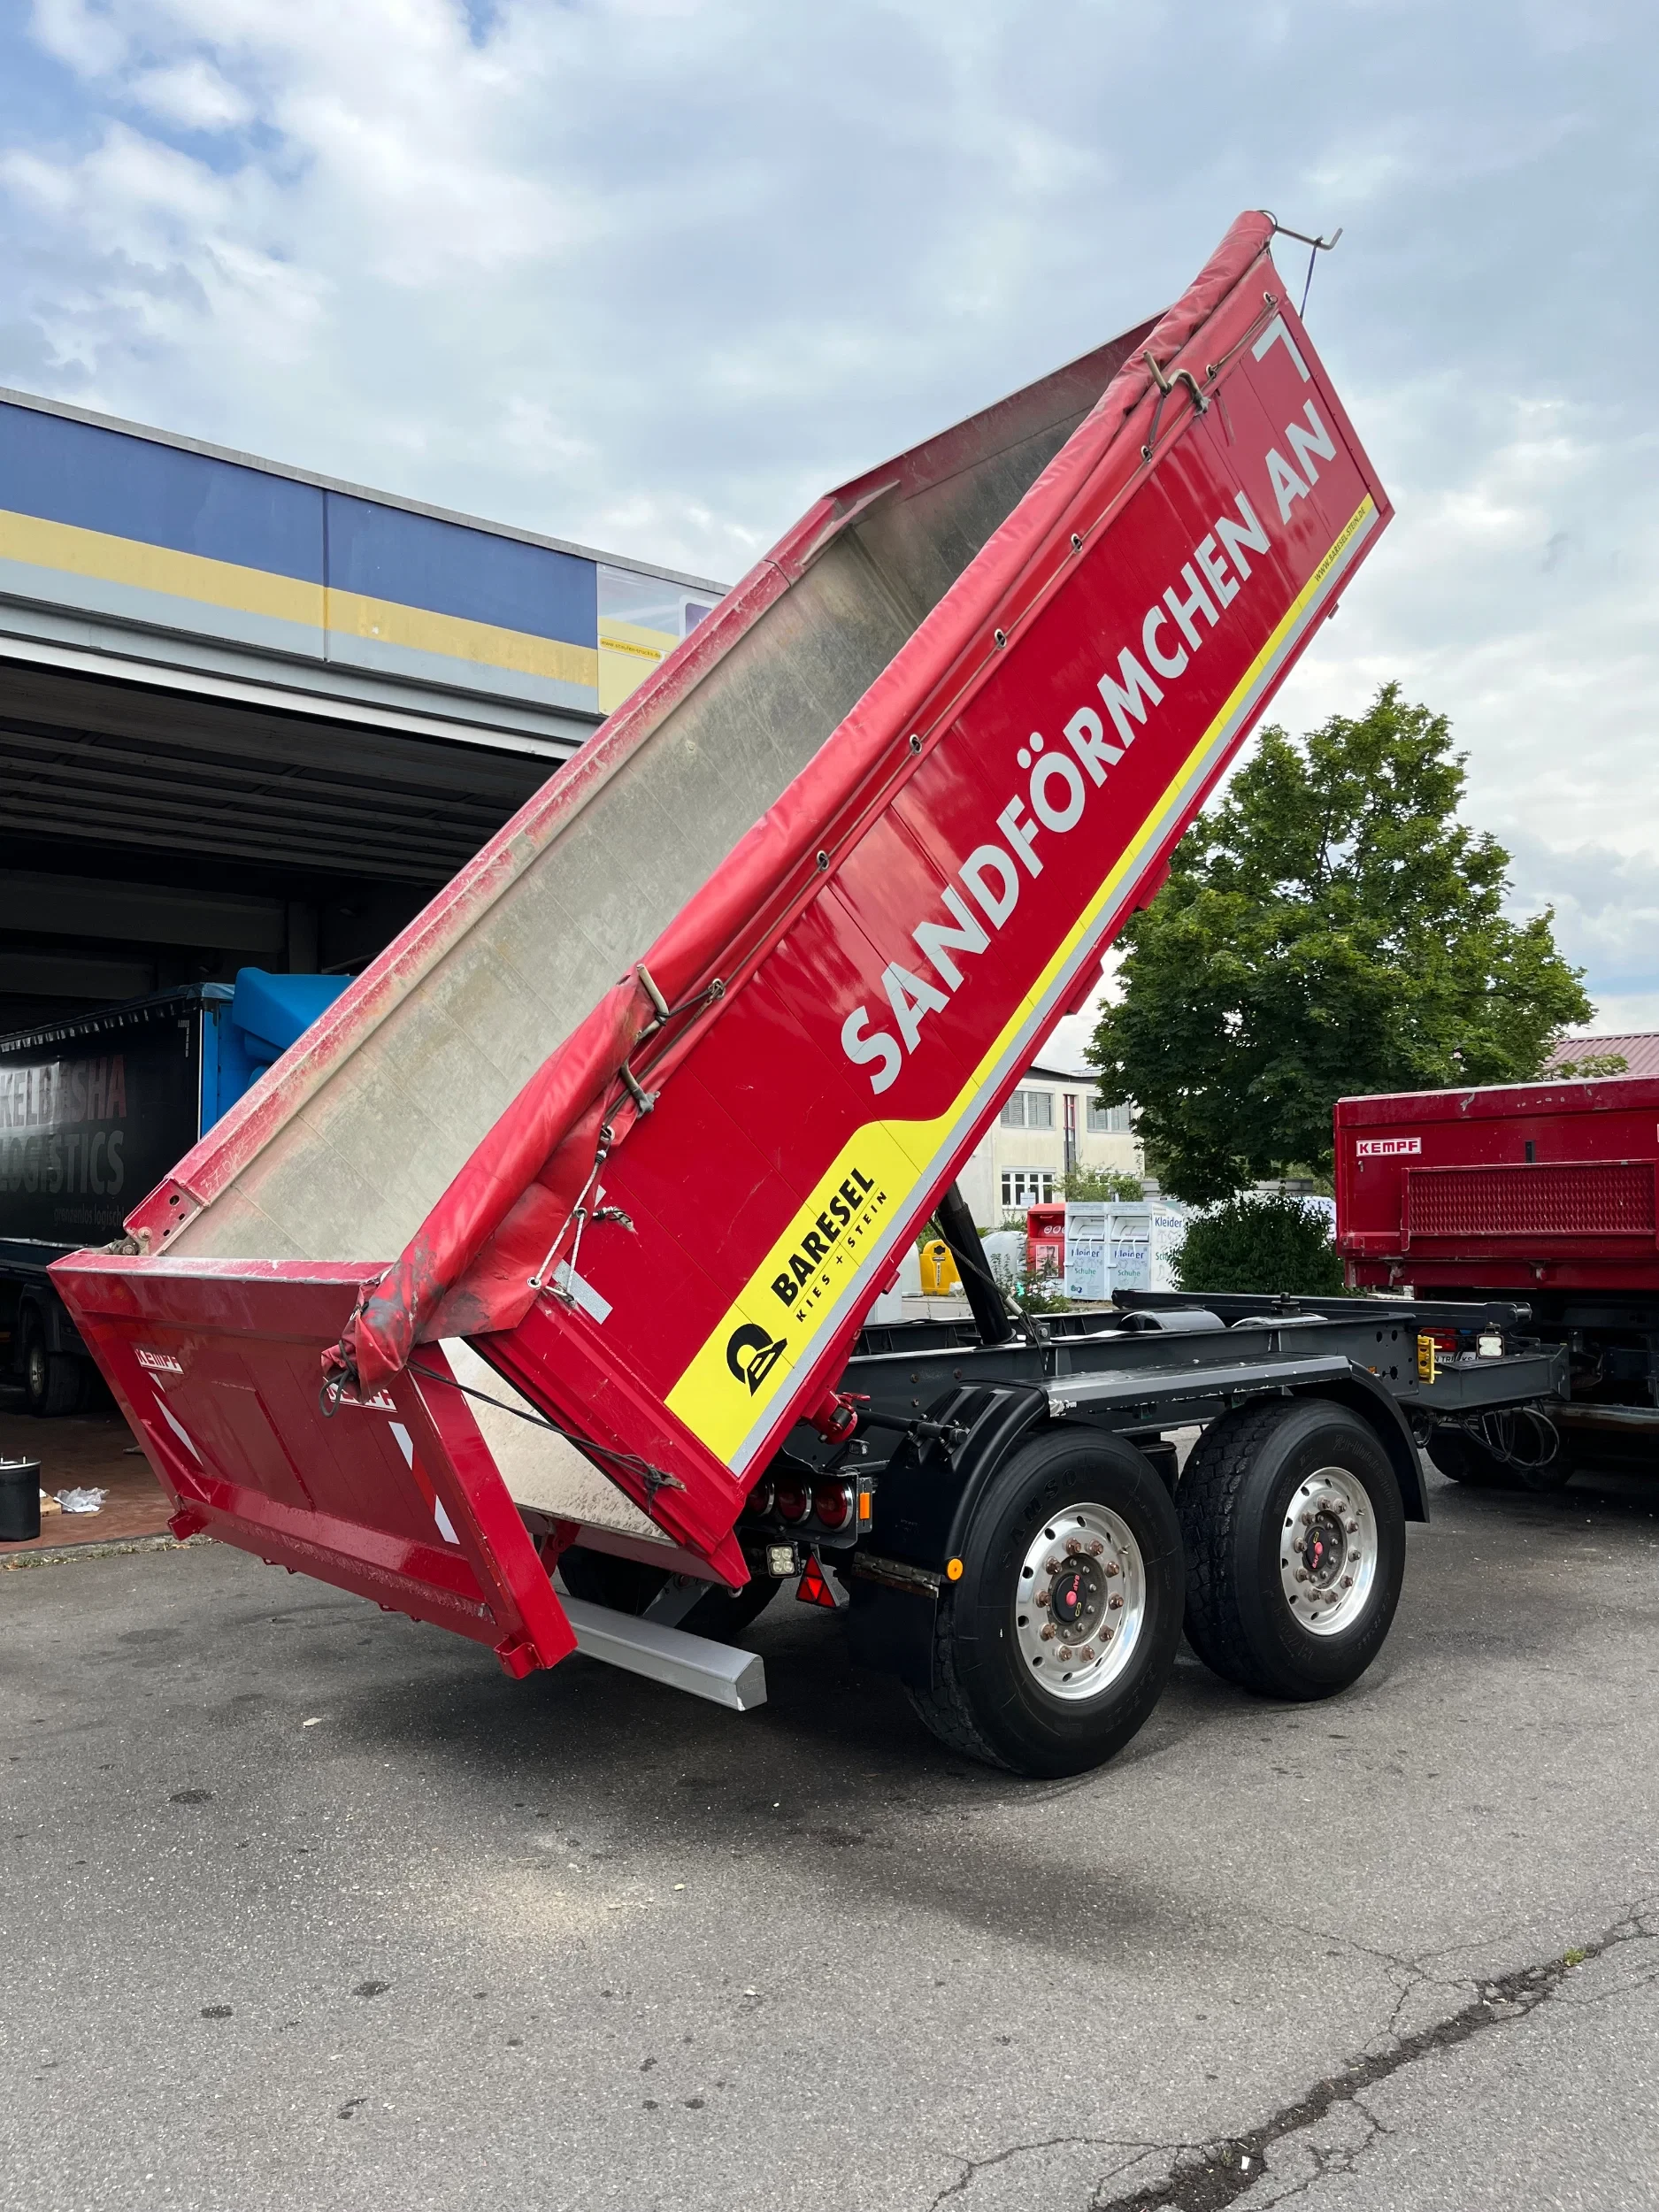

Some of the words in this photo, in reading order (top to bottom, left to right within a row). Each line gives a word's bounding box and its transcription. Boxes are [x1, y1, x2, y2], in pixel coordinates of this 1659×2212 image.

[1314, 507, 1366, 581] WWW.BARESEL-STEIN.DE
[840, 490, 1271, 1094] SANDFÖRMCHEN
[1265, 399, 1336, 525] AN
[1360, 1141, 1417, 1154] KEMPF
[54, 1203, 93, 1226] grenzenlos
[771, 1168, 874, 1308] BARESEL
[1155, 1217, 1182, 1227] Kleider
[796, 1274, 830, 1322] KIES
[848, 1191, 887, 1248] STEIN
